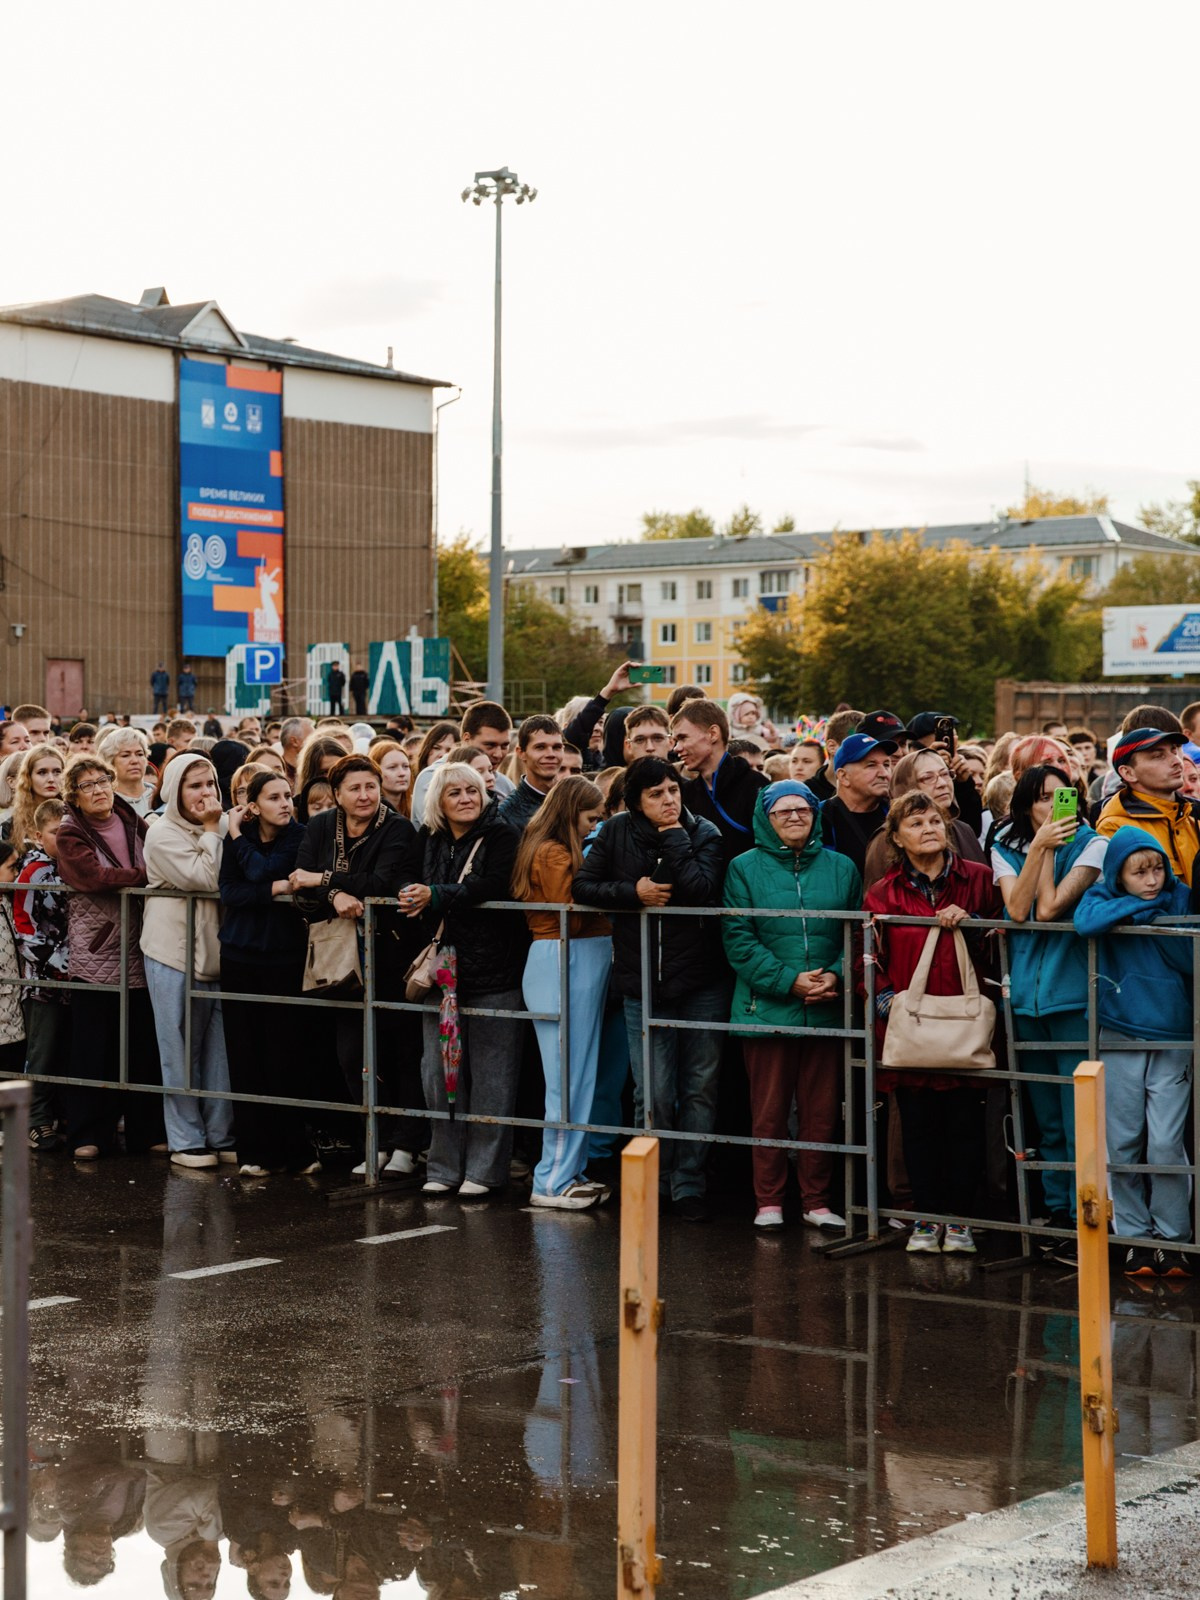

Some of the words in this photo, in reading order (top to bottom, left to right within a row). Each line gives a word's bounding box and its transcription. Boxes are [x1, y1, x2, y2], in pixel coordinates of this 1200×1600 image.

[199, 487, 227, 499] ВРЕМЯ
[228, 489, 266, 504] ВЕЛИКИХ
[184, 533, 227, 580] 80
[254, 649, 275, 681] P
